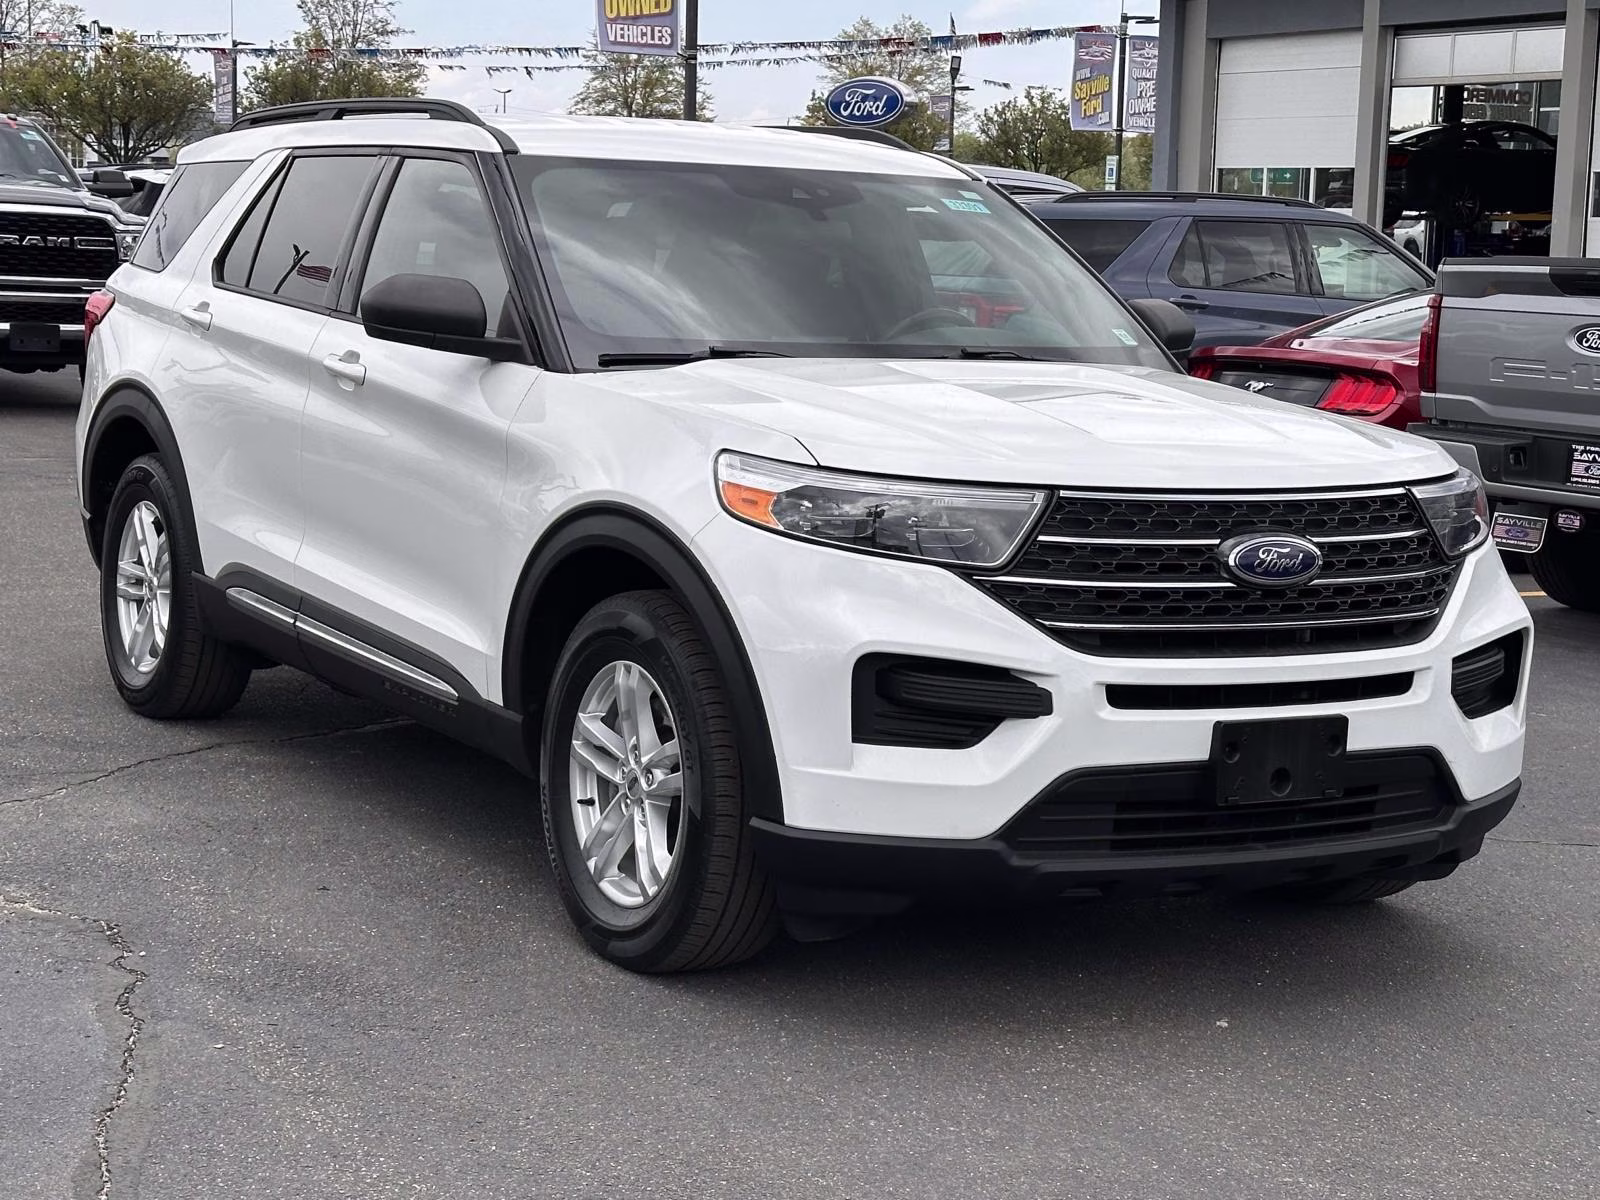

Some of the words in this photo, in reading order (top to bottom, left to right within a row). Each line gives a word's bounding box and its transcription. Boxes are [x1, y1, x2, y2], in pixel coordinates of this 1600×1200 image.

[605, 0, 672, 19] OWNED
[606, 23, 672, 45] VEHICLES
[1132, 68, 1157, 79] QUALIT
[1074, 75, 1110, 100] Sayville
[840, 88, 887, 116] Ford
[1081, 94, 1103, 118] Ford
[1128, 97, 1157, 114] OWNE
[1128, 116, 1155, 127] VEHICLE
[1490, 356, 1600, 390] F-1
[1573, 452, 1600, 462] SAYV
[1497, 517, 1542, 528] SAYVILLE
[1254, 546, 1303, 572] Ford
